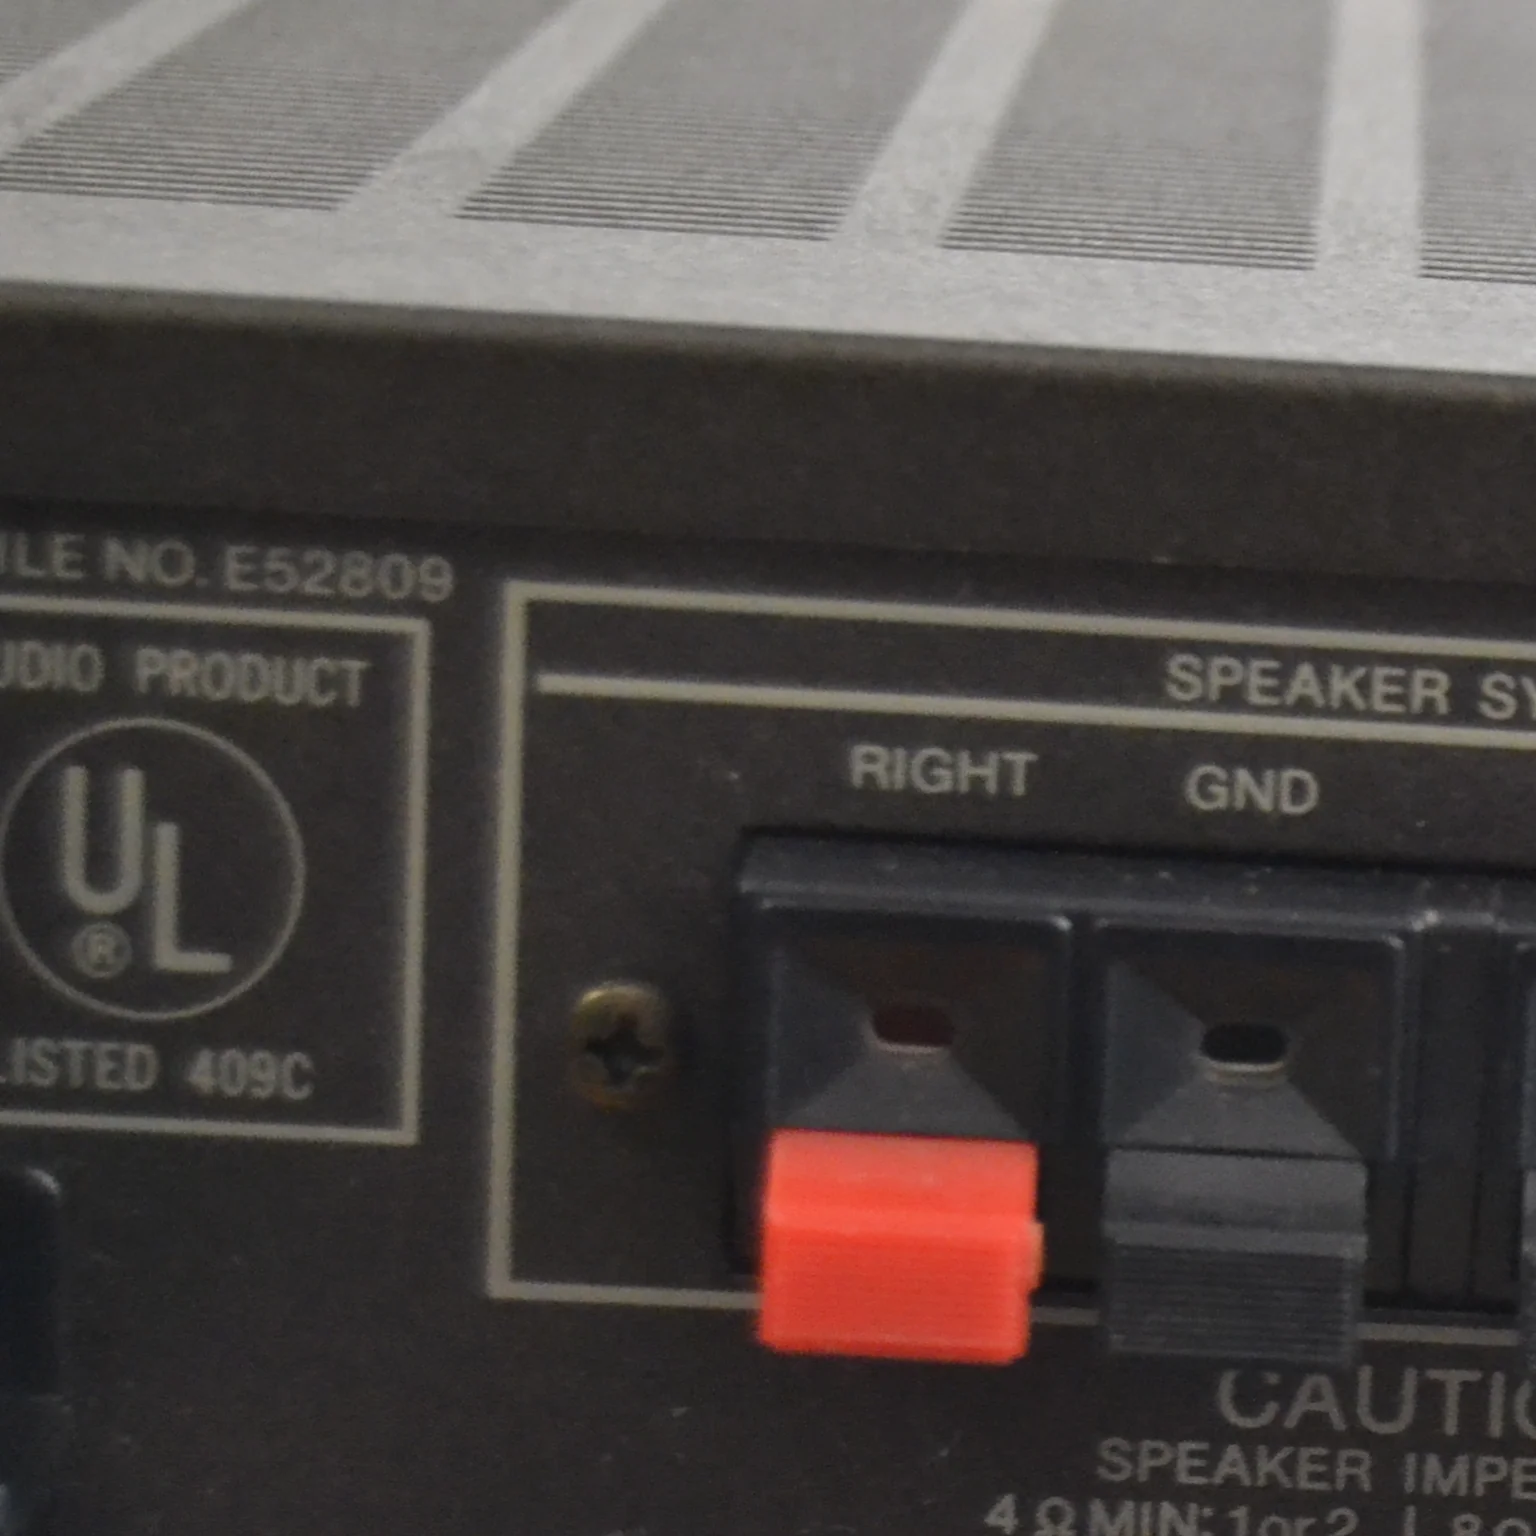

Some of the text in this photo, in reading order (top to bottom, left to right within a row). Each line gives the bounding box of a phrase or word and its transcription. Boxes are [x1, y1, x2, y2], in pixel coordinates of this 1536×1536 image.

[104, 539, 210, 587] NO.
[225, 545, 454, 601] E52809
[136, 649, 369, 706] PRODUCT
[1166, 657, 1450, 715] SPEAKER
[851, 745, 1036, 797] RIGHT
[1187, 766, 1318, 813] GND
[0, 1043, 314, 1099] ISTED 409C
[1096, 1439, 1370, 1492] SPEAKER
